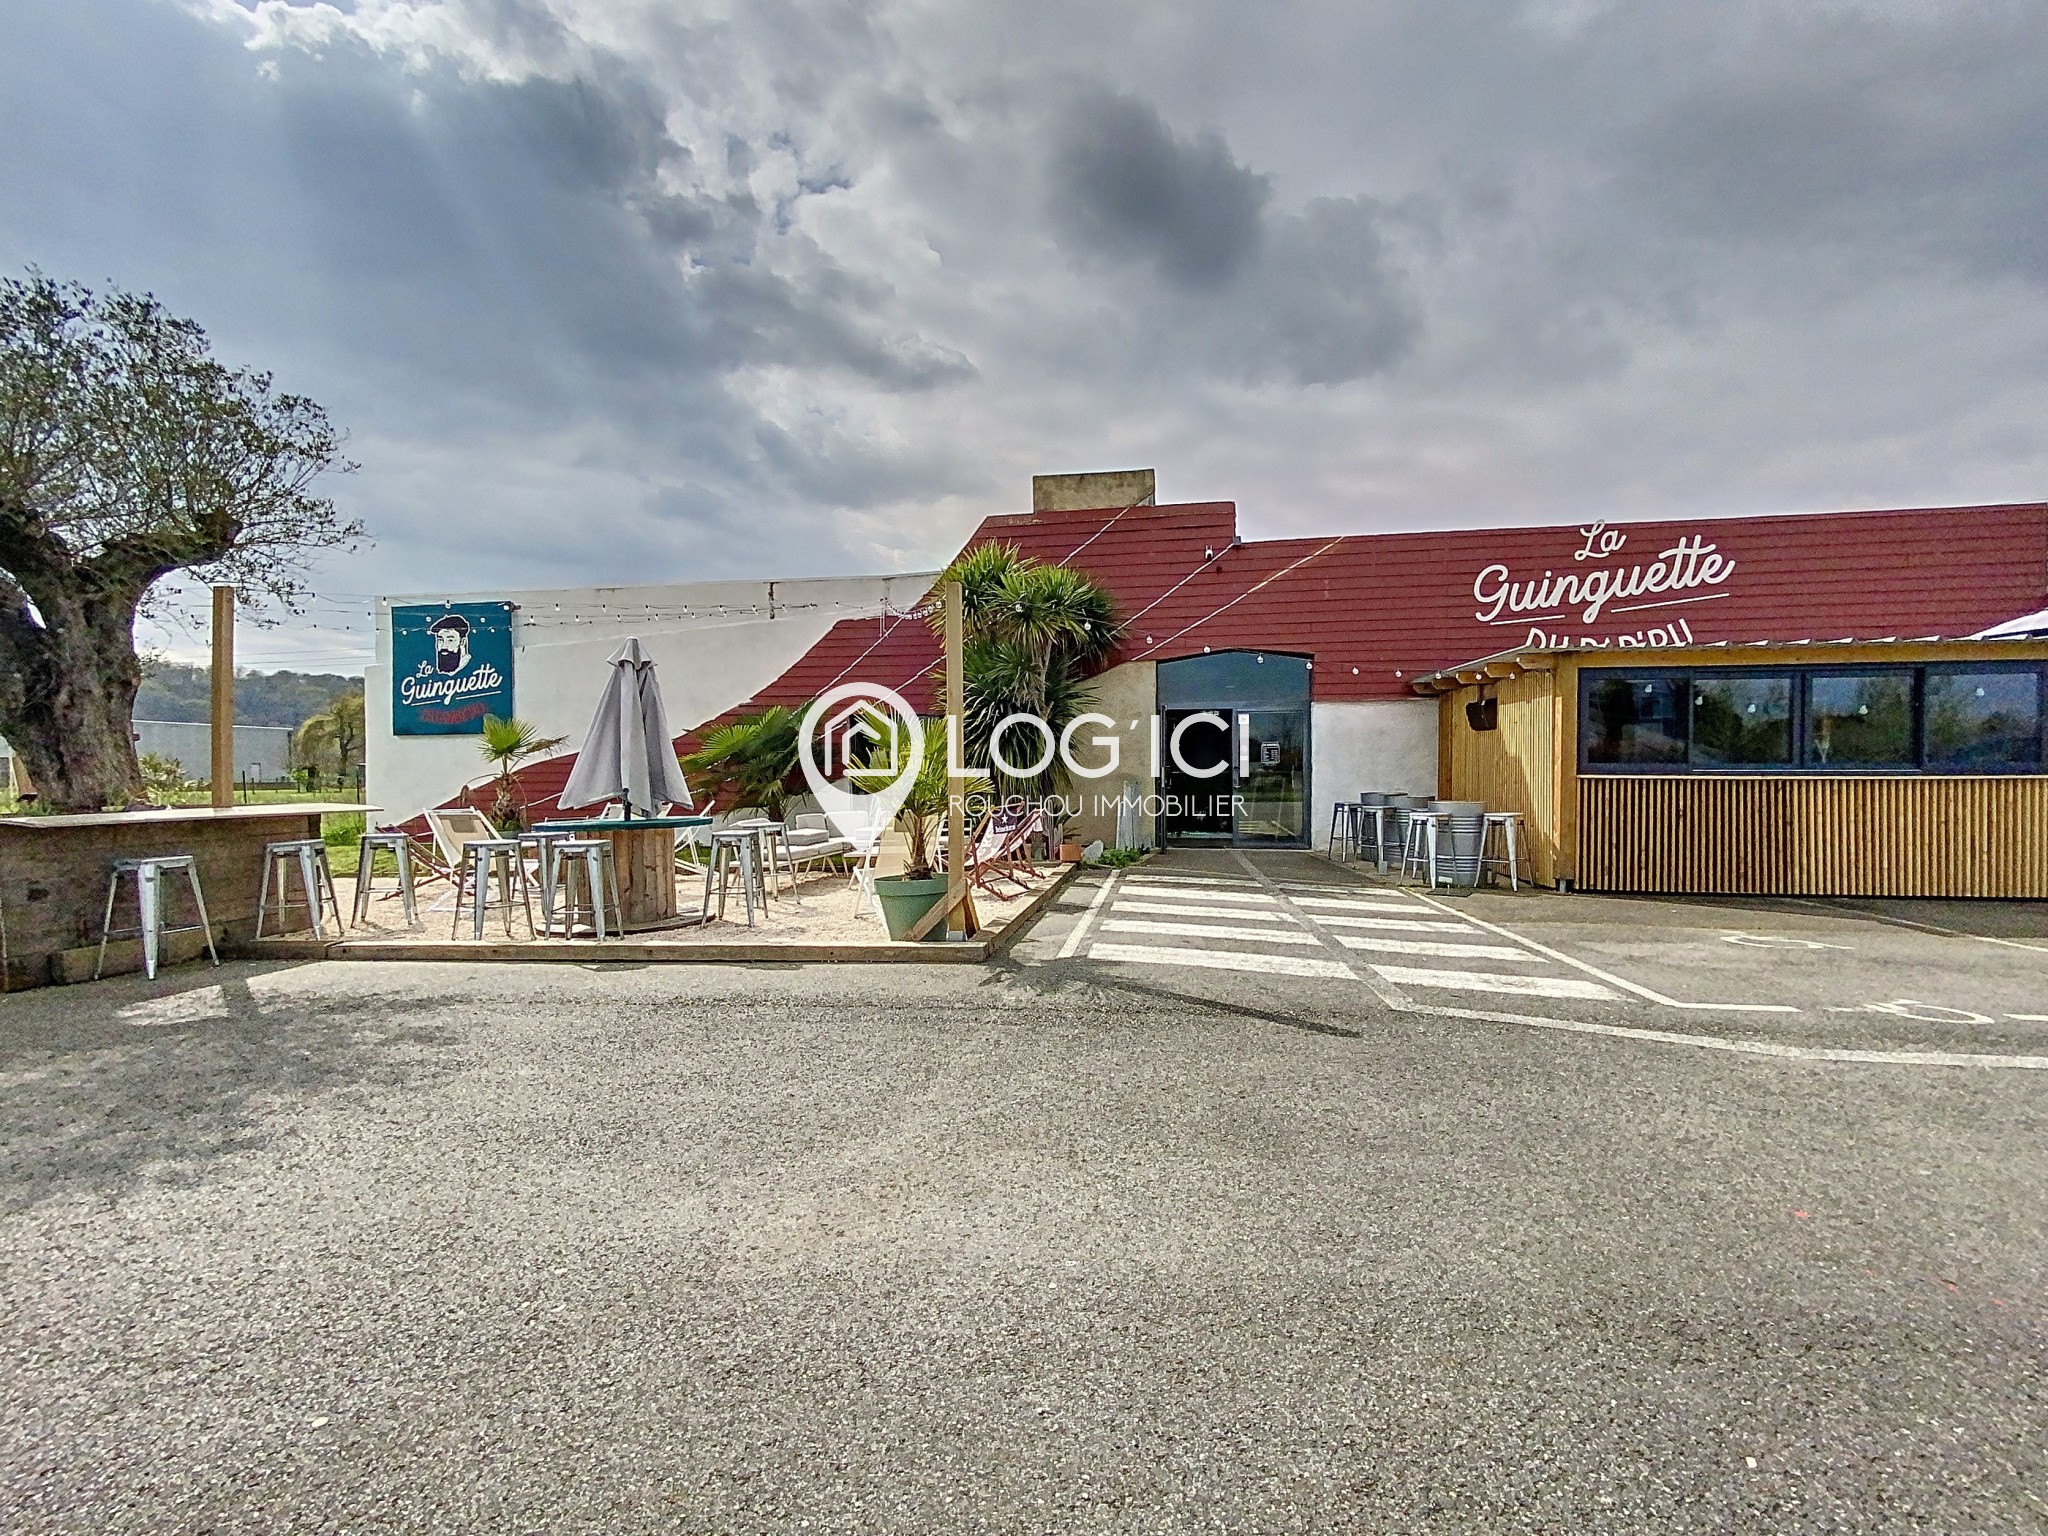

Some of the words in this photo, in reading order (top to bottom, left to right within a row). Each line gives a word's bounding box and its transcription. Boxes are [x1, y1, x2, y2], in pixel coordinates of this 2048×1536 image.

[1575, 519, 1626, 561] La
[1473, 534, 1736, 624] Guinguette
[401, 663, 503, 705] Guinguette
[416, 660, 434, 678] La
